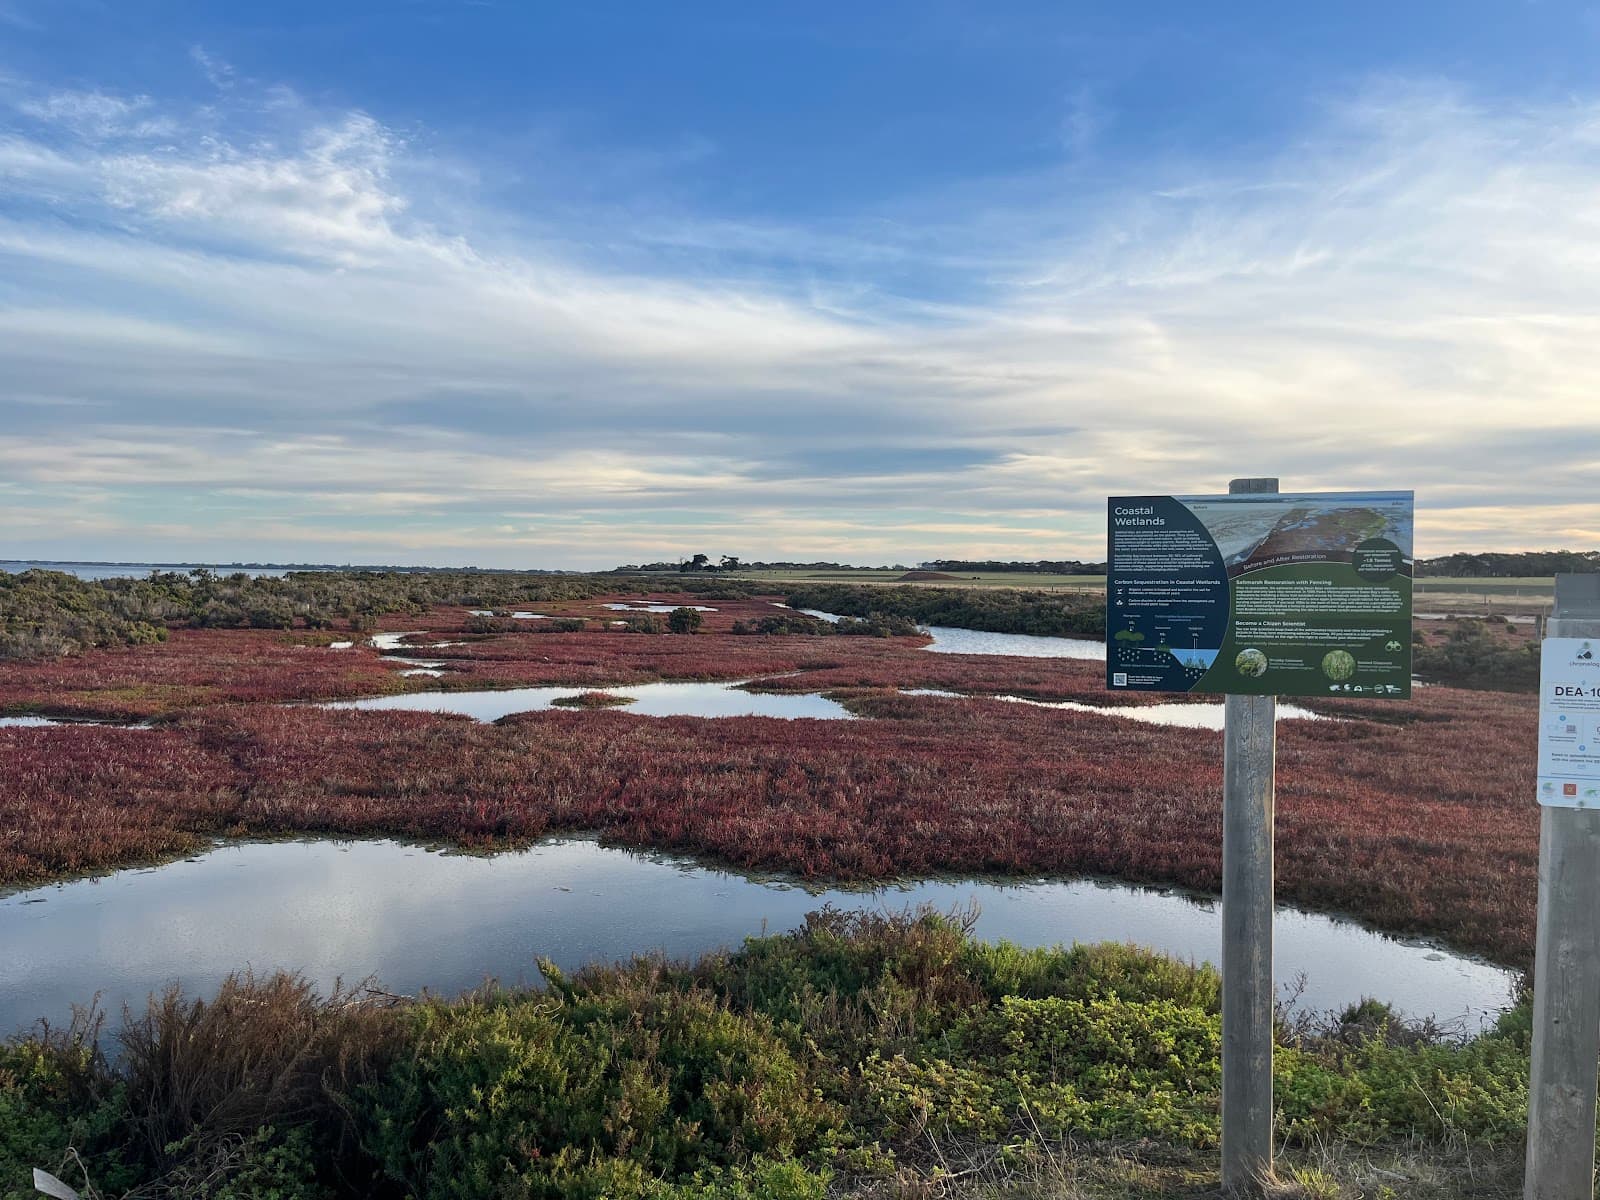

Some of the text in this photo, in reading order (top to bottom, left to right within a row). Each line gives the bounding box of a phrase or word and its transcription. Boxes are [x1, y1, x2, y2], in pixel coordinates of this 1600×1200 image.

[1114, 506, 1153, 515] Coastal
[1114, 517, 1165, 526] Wetlands
[1243, 561, 1262, 570] Before
